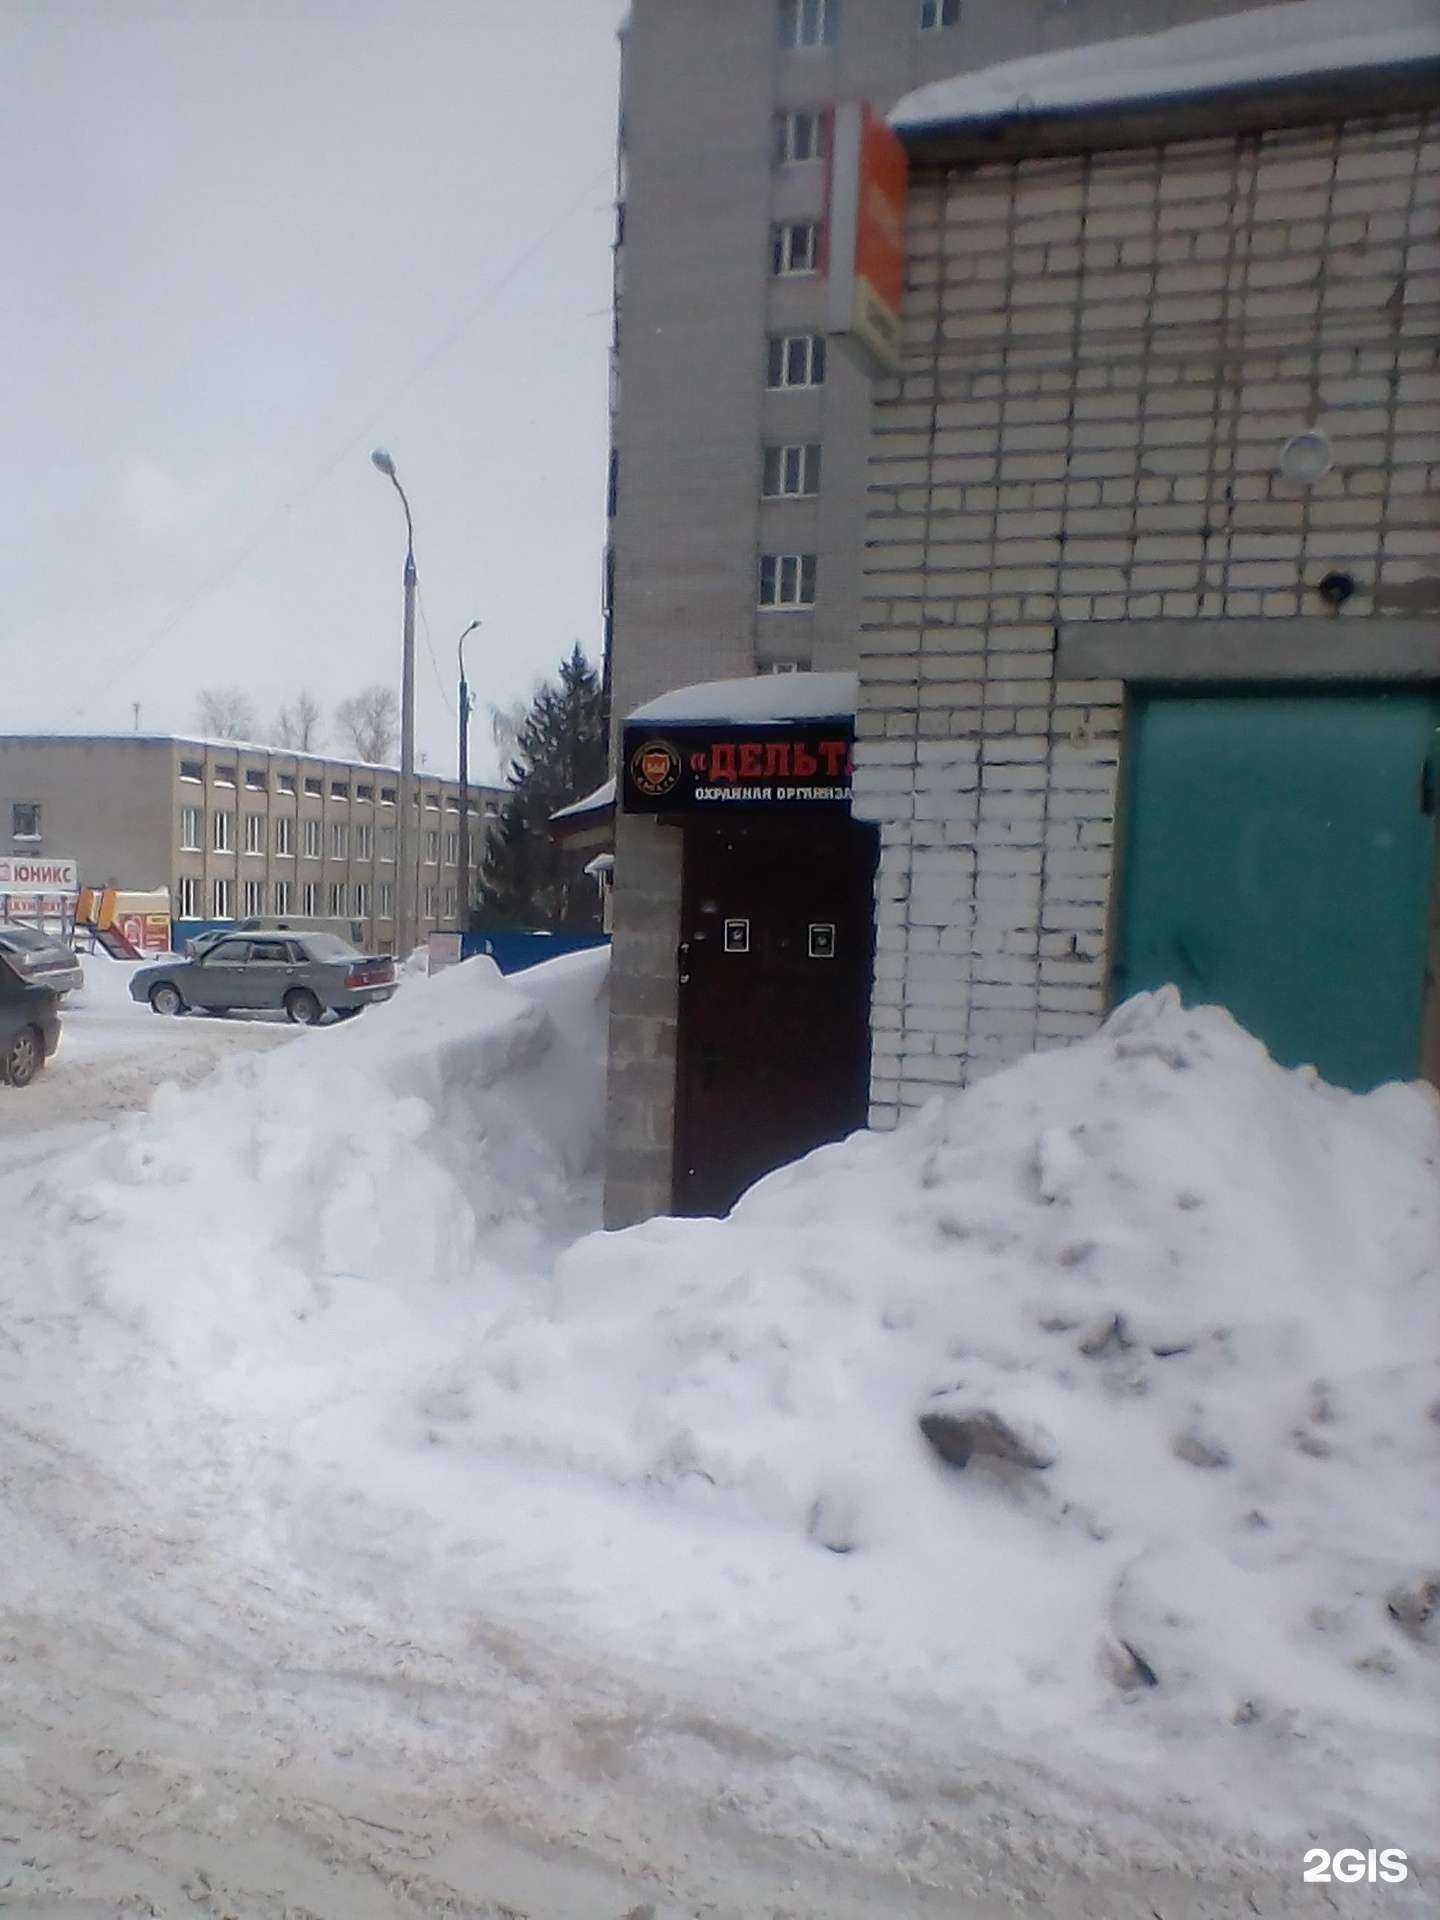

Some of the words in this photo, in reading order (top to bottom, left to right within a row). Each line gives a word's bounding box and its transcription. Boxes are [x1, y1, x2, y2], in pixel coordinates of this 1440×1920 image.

[690, 741, 854, 783] «ДЕЛЬТ
[695, 787, 772, 801] ОХРАННАЯ
[14, 866, 72, 883] ЮНИКС
